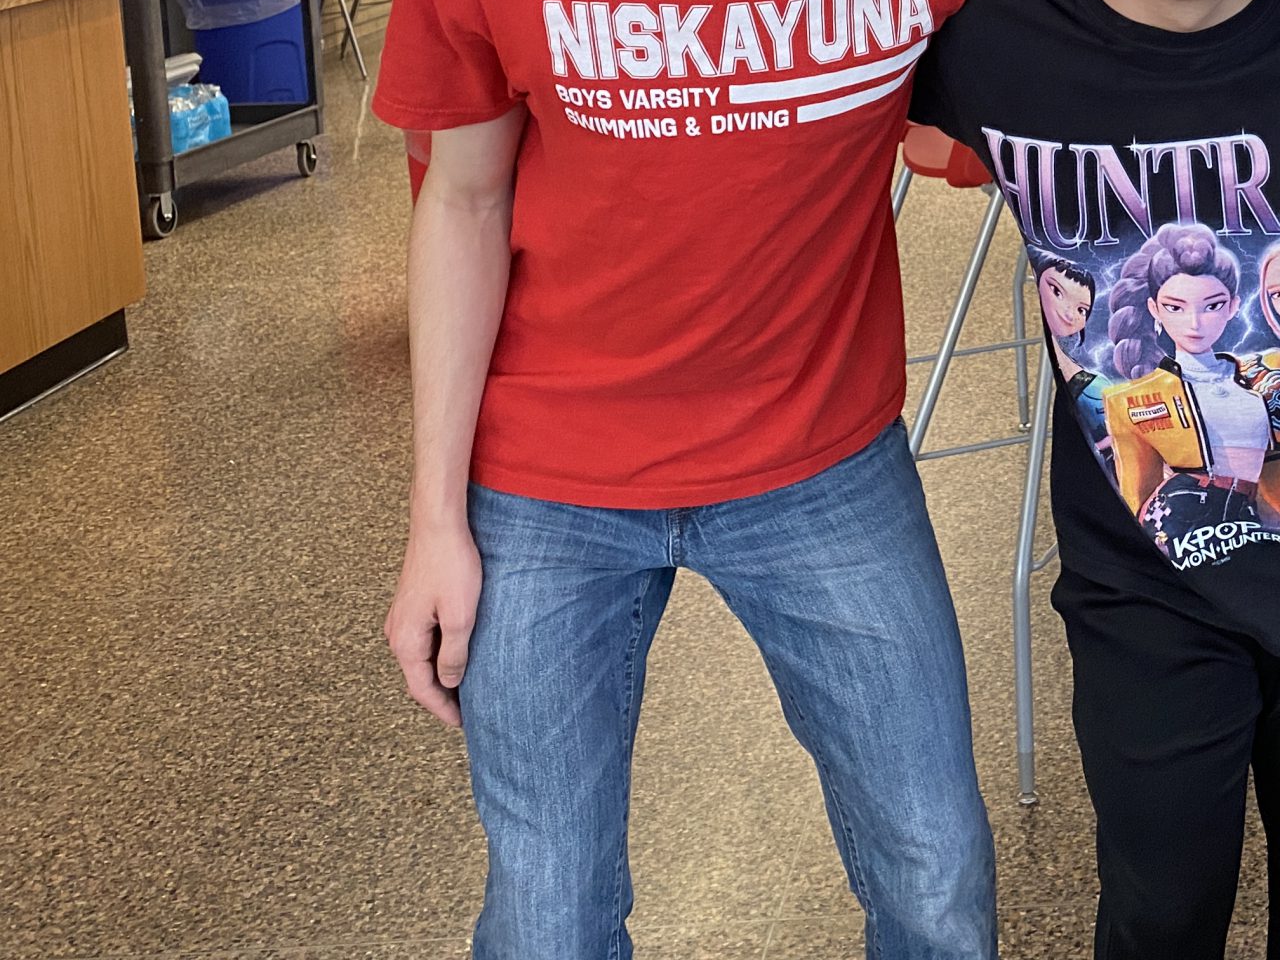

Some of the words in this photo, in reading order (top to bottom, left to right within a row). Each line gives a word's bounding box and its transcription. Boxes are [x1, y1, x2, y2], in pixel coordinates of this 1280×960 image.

[555, 83, 613, 110] BOYS
[619, 87, 721, 110] VARSITY
[564, 107, 678, 140] SWIMMING
[685, 116, 702, 137] &
[710, 109, 790, 135] DIVING
[1172, 521, 1262, 559] KPOP
